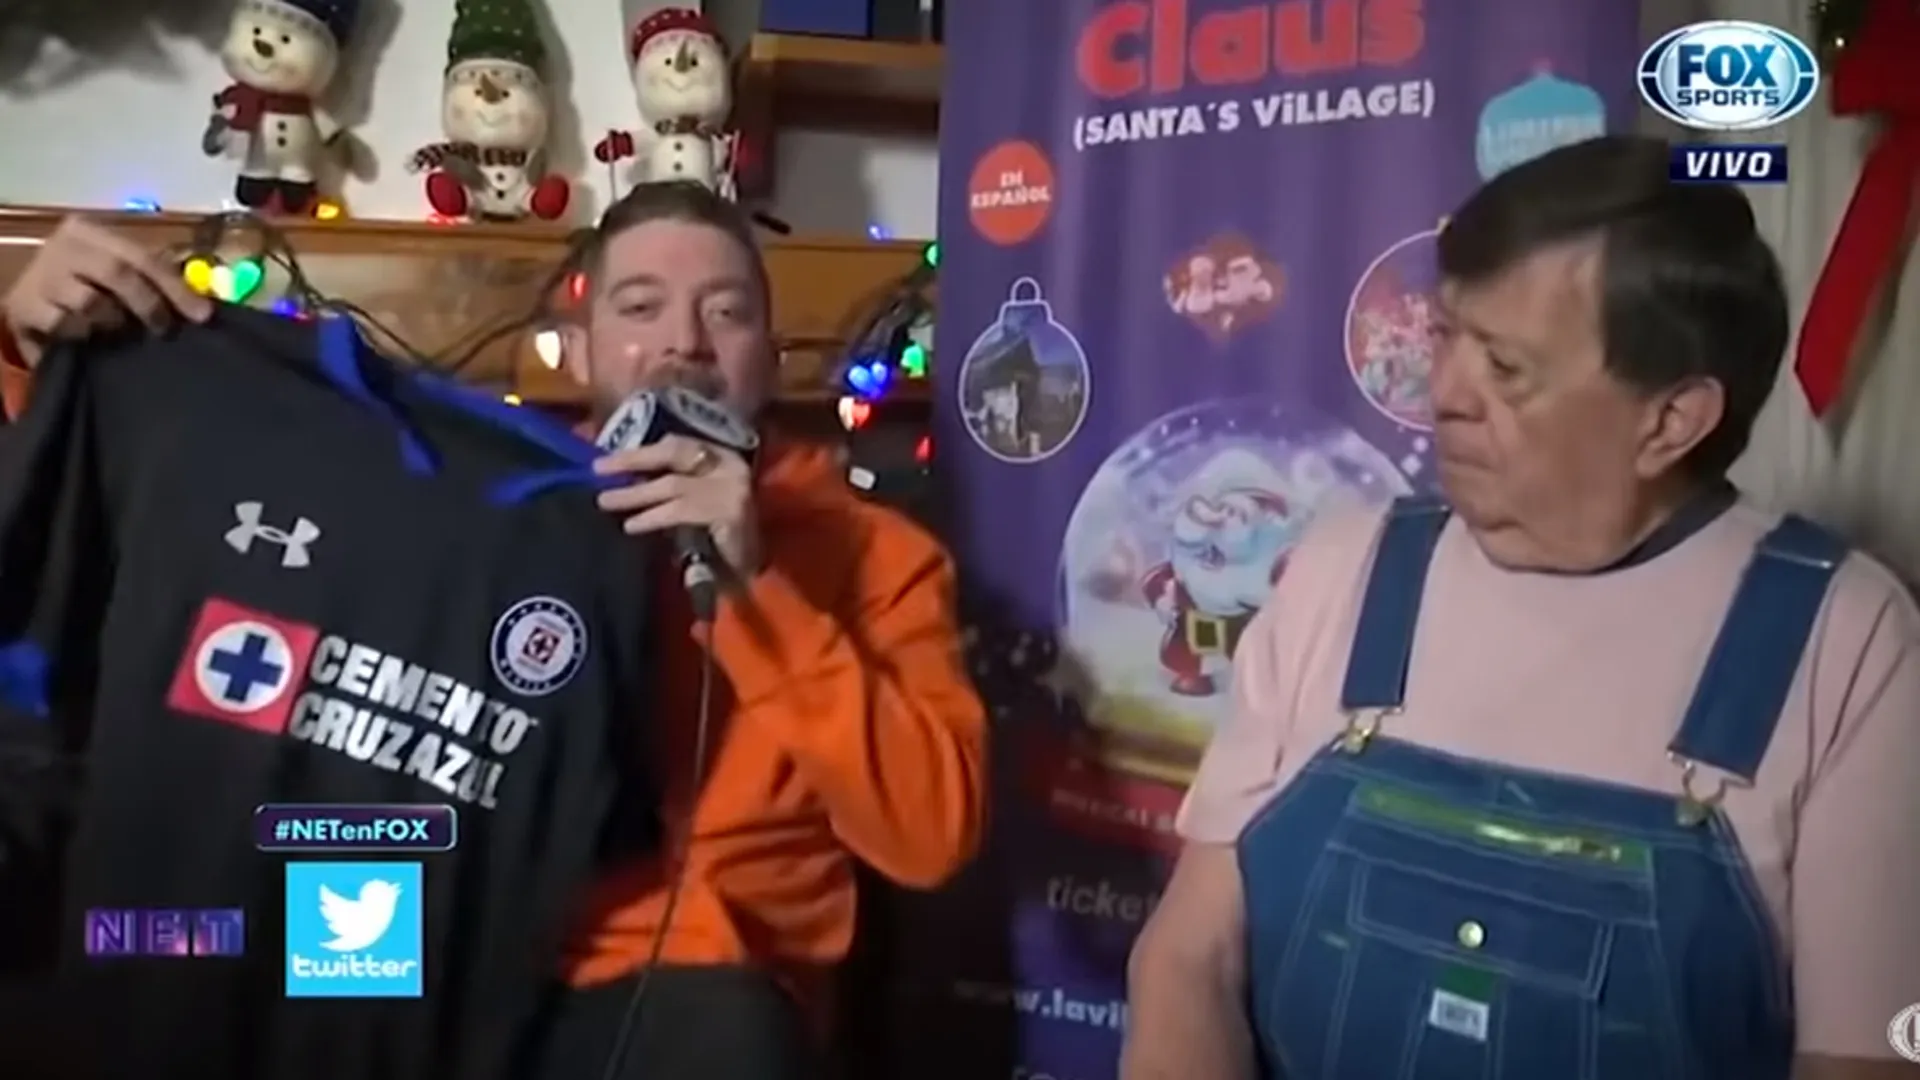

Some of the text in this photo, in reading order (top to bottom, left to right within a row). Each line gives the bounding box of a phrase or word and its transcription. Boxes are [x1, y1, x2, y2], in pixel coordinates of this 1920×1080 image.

[288, 692, 504, 809] CRUZ AZUL
[310, 635, 529, 754] CEMENTO
